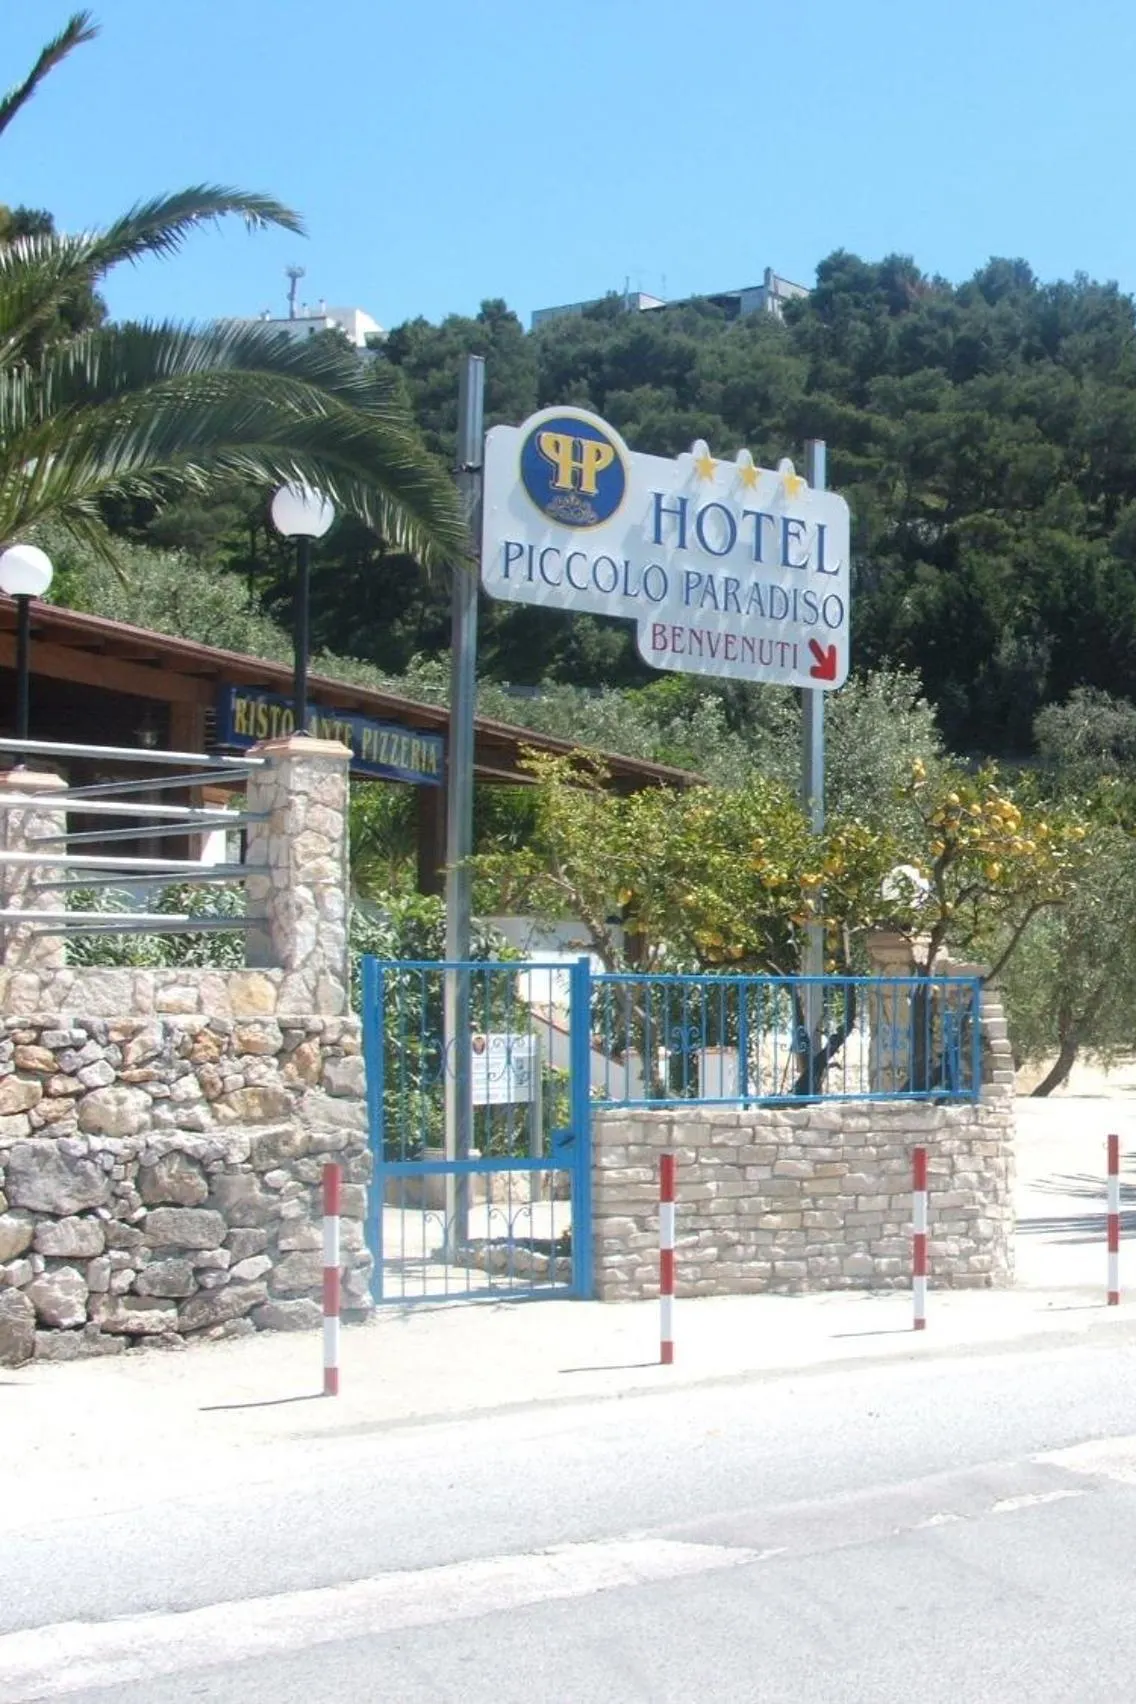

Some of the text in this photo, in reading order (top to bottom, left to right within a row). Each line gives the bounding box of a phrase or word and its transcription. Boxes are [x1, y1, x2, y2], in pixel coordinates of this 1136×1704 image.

[651, 491, 841, 577] HOTEL
[503, 540, 845, 629] PICCOLO PARADISO
[651, 622, 798, 670] BENVENUTI
[235, 697, 437, 775] RISTOANTE PIZZERIA
